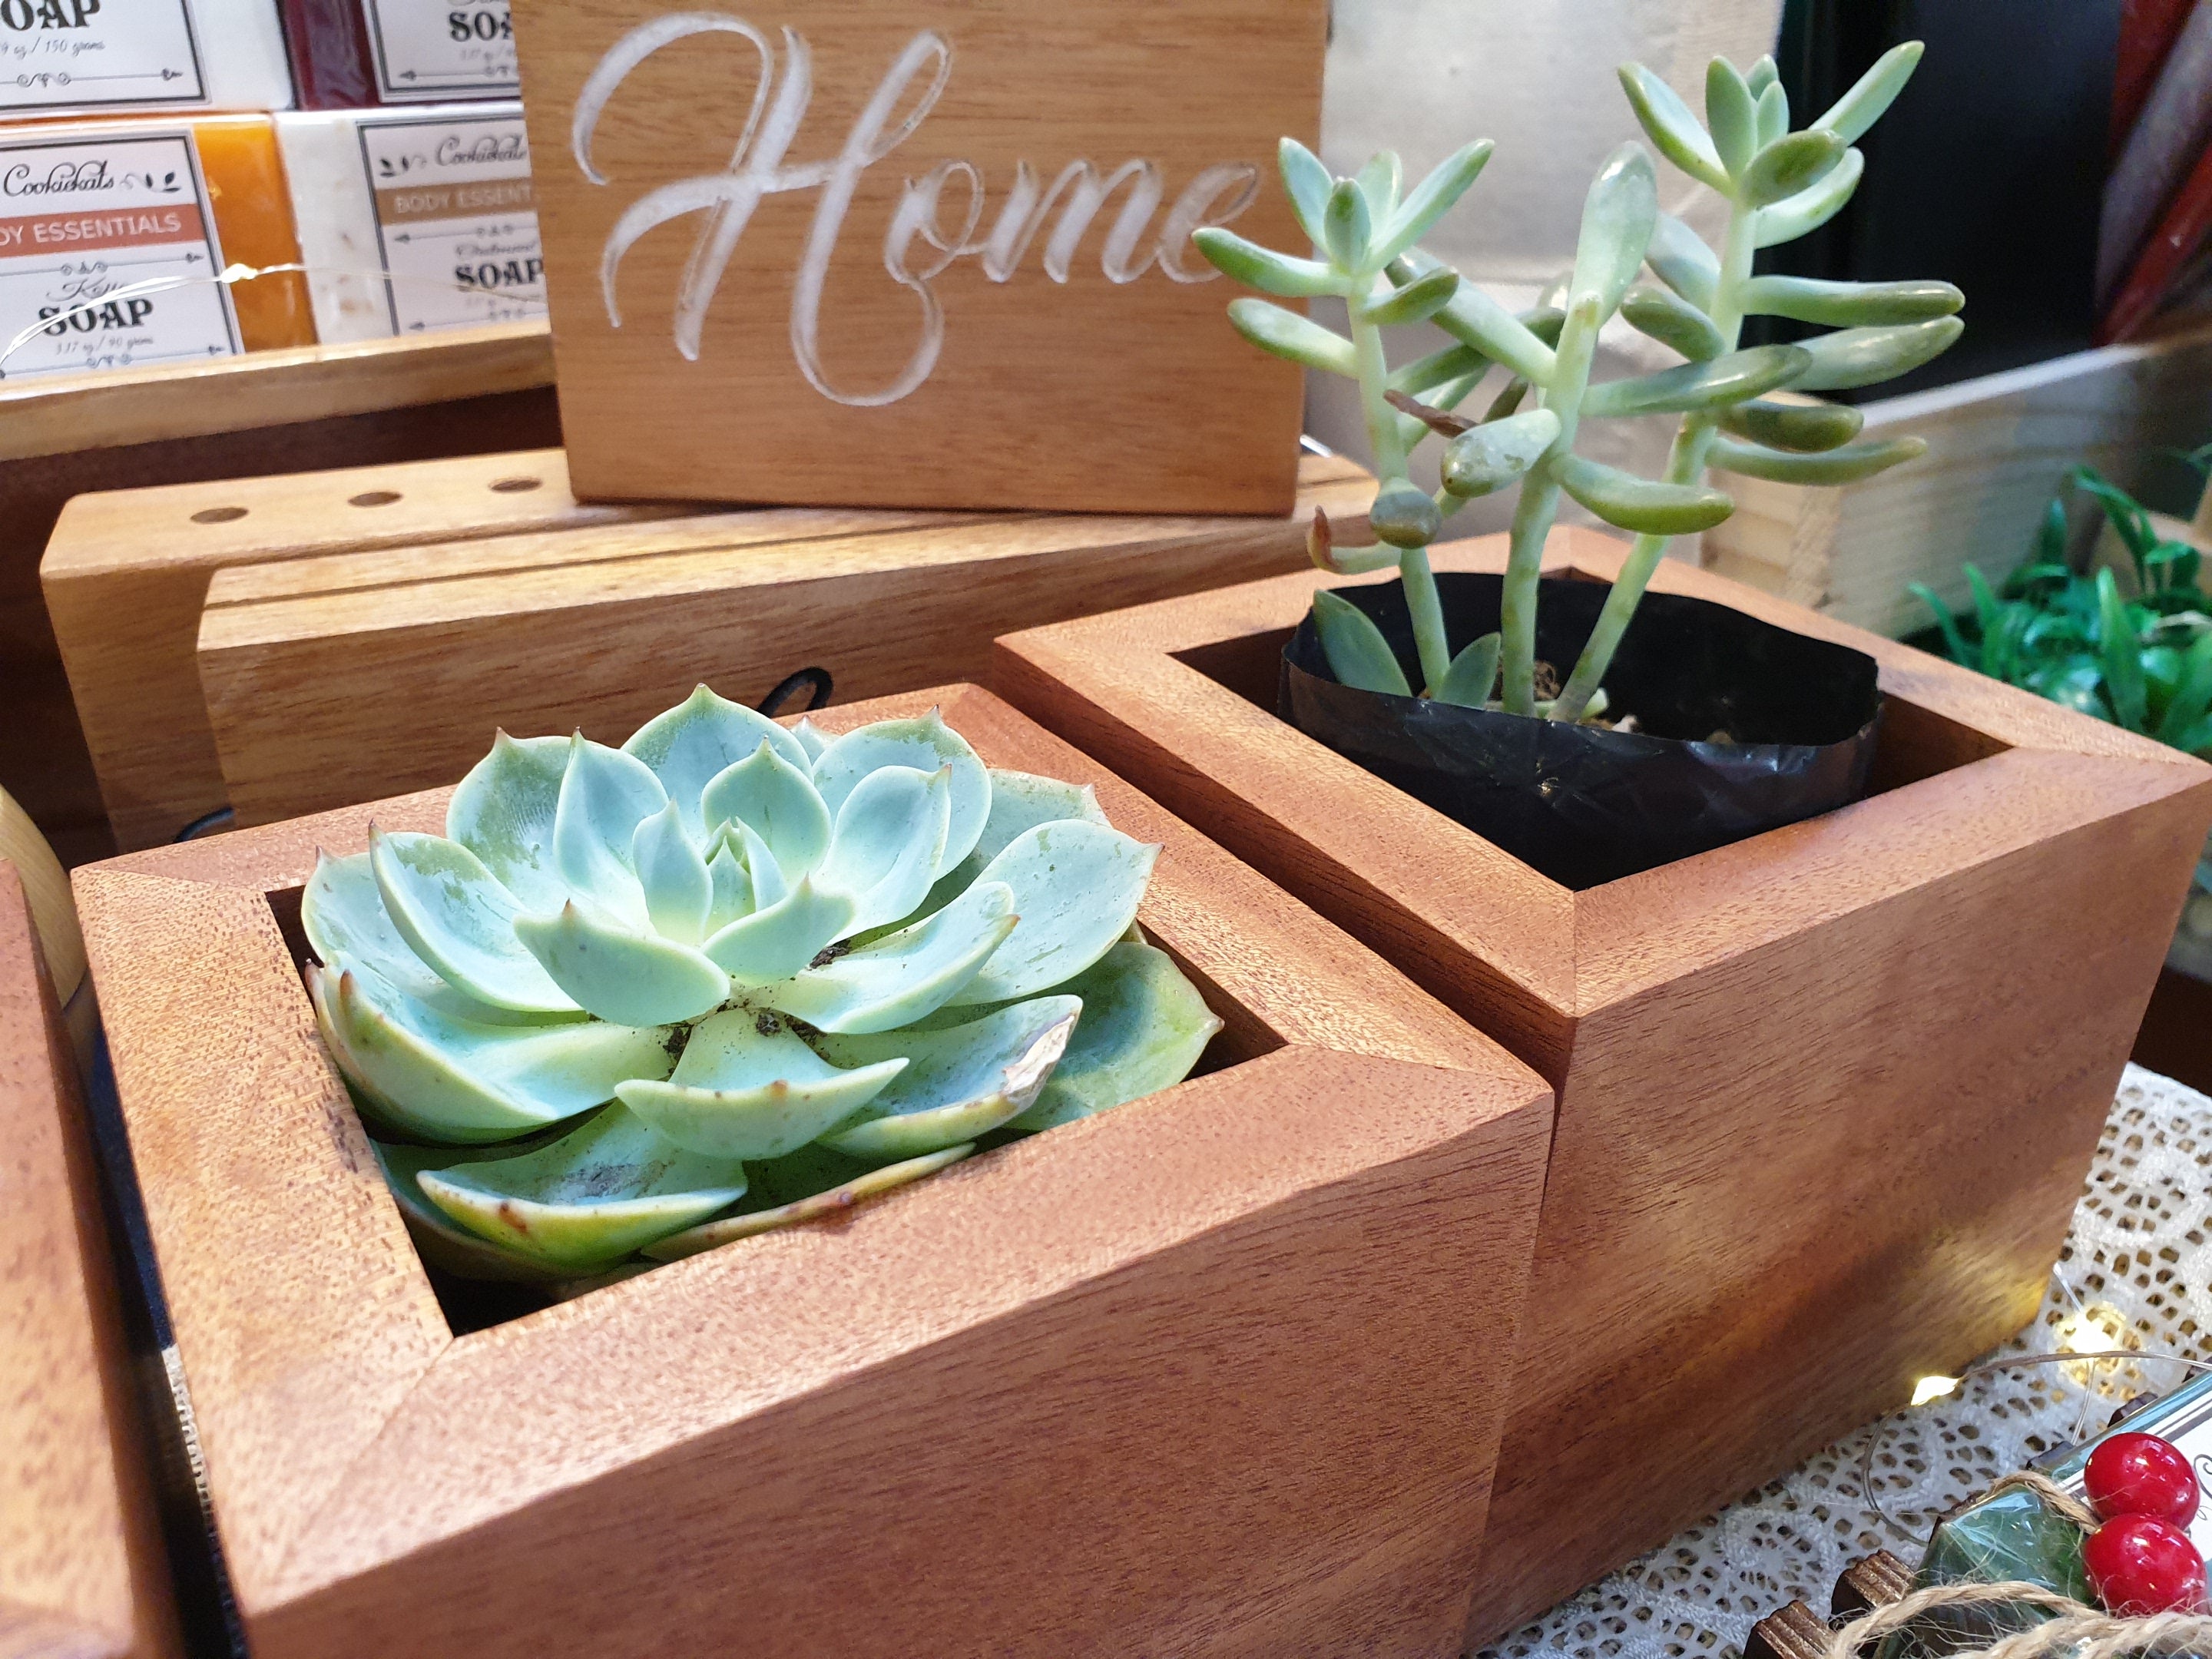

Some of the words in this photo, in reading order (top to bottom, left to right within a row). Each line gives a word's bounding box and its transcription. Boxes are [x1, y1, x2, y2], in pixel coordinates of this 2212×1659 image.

[393, 192, 451, 214] BODY
[571, 11, 1262, 408] Home
[33, 212, 182, 243] ESSENTIALS
[455, 257, 544, 293] SOAP
[38, 297, 154, 336] SOAP
